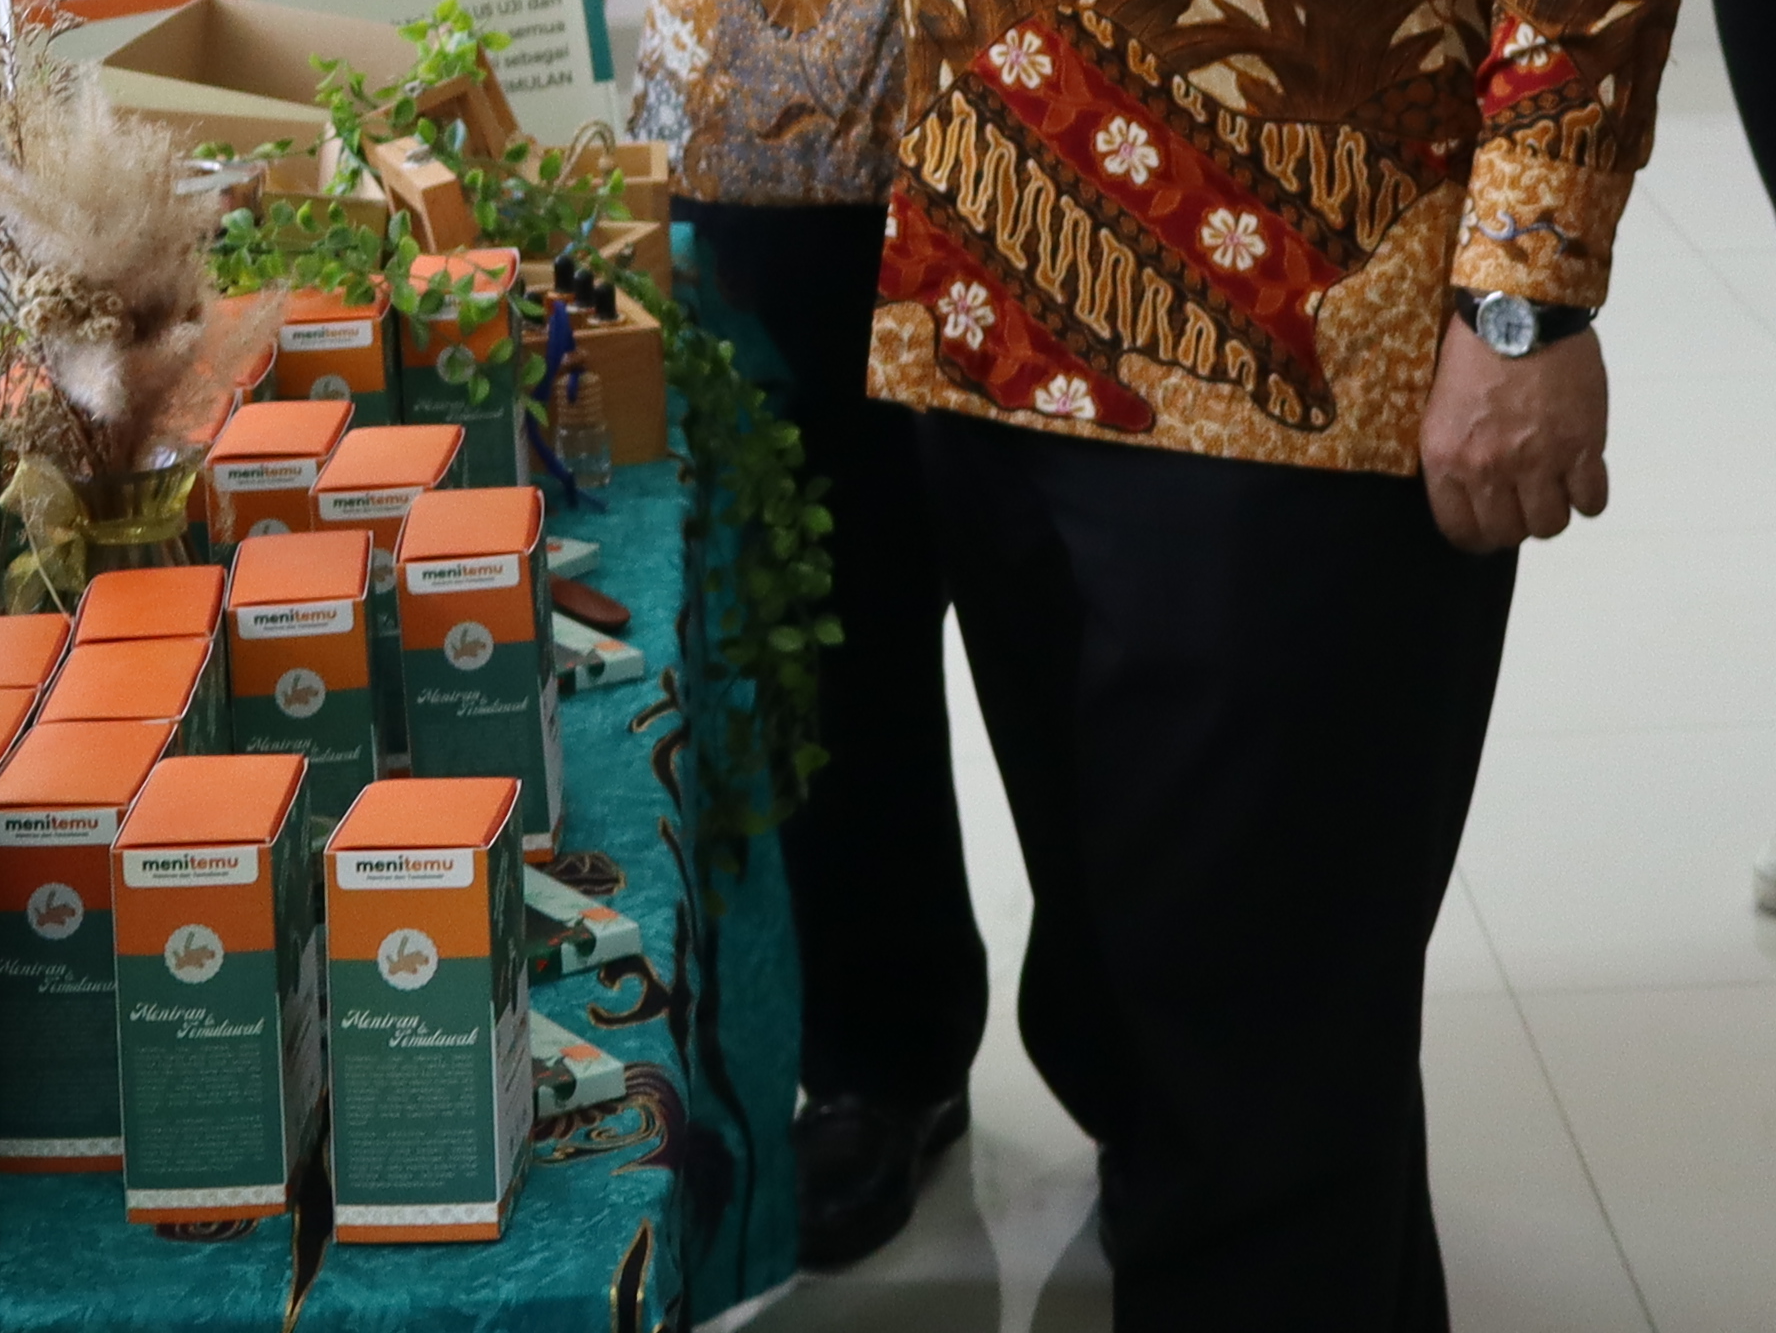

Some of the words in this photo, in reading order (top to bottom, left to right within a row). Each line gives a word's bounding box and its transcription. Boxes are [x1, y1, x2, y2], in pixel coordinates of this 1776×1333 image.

[292, 325, 360, 342] menitemu
[228, 463, 303, 481] menitemu
[332, 492, 410, 509] menitemu
[422, 563, 504, 582] menitemu
[253, 607, 338, 627] menitemu
[4, 813, 100, 833] menitemu
[142, 852, 240, 873] menitemu
[355, 854, 454, 873] menitemu
[129, 1001, 207, 1022] Meniran
[341, 1009, 420, 1030] Meniran
[176, 1017, 265, 1039] Temulawak
[389, 1026, 480, 1048] Temulawak
